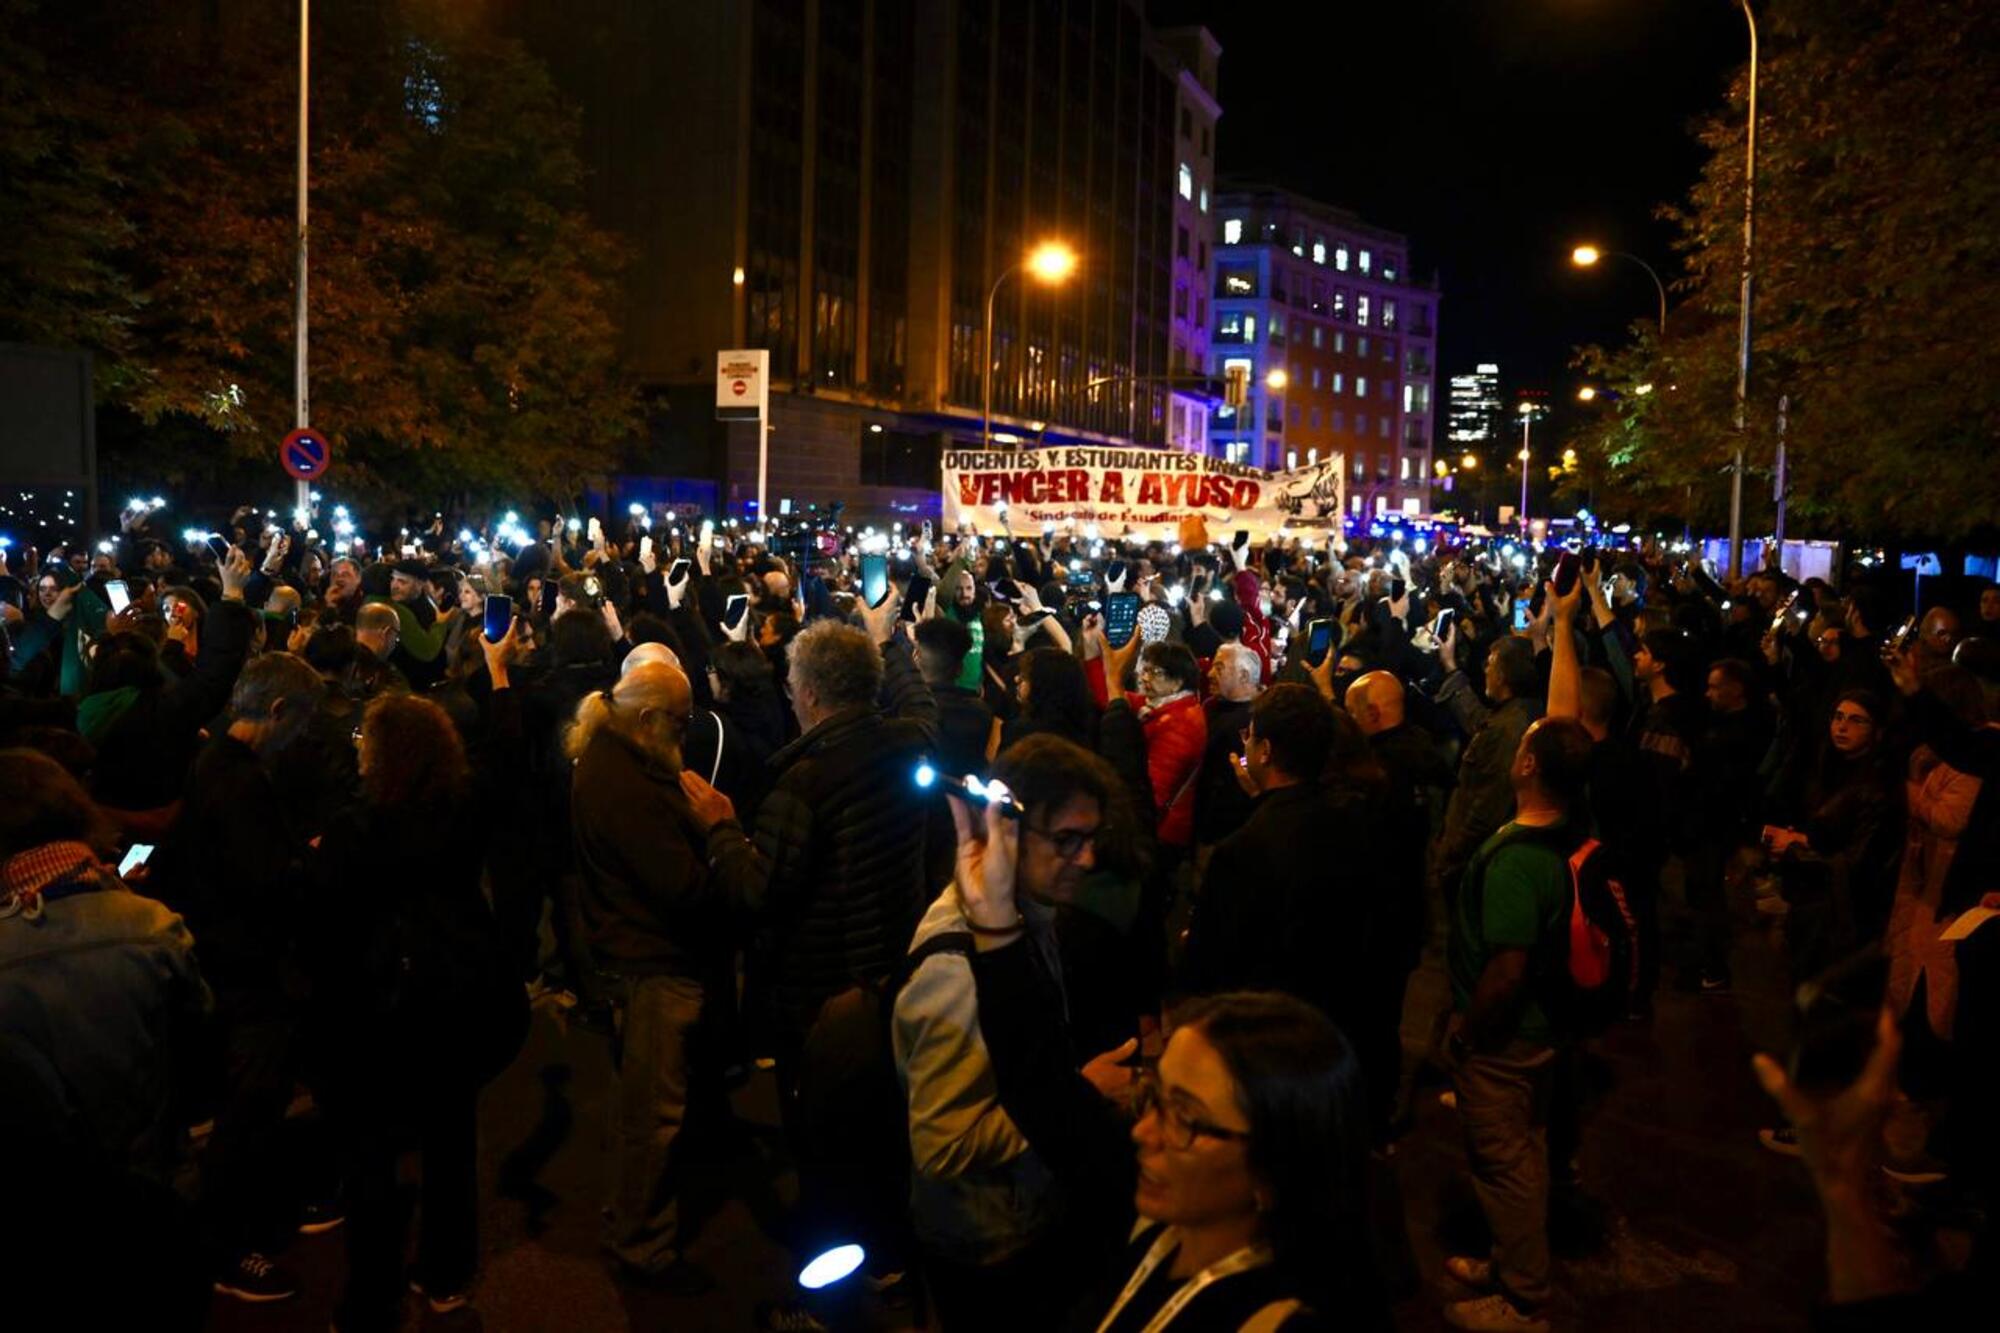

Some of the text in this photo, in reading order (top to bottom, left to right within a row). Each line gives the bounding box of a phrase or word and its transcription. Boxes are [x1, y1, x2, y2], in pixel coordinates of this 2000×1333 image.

[946, 452, 1040, 470] DOCENTES
[1047, 450, 1059, 467] Y
[1065, 449, 1198, 471] ESTUDIANTES
[959, 469, 1260, 511] VENCER A AYUSO
[1098, 511, 1117, 521] de
